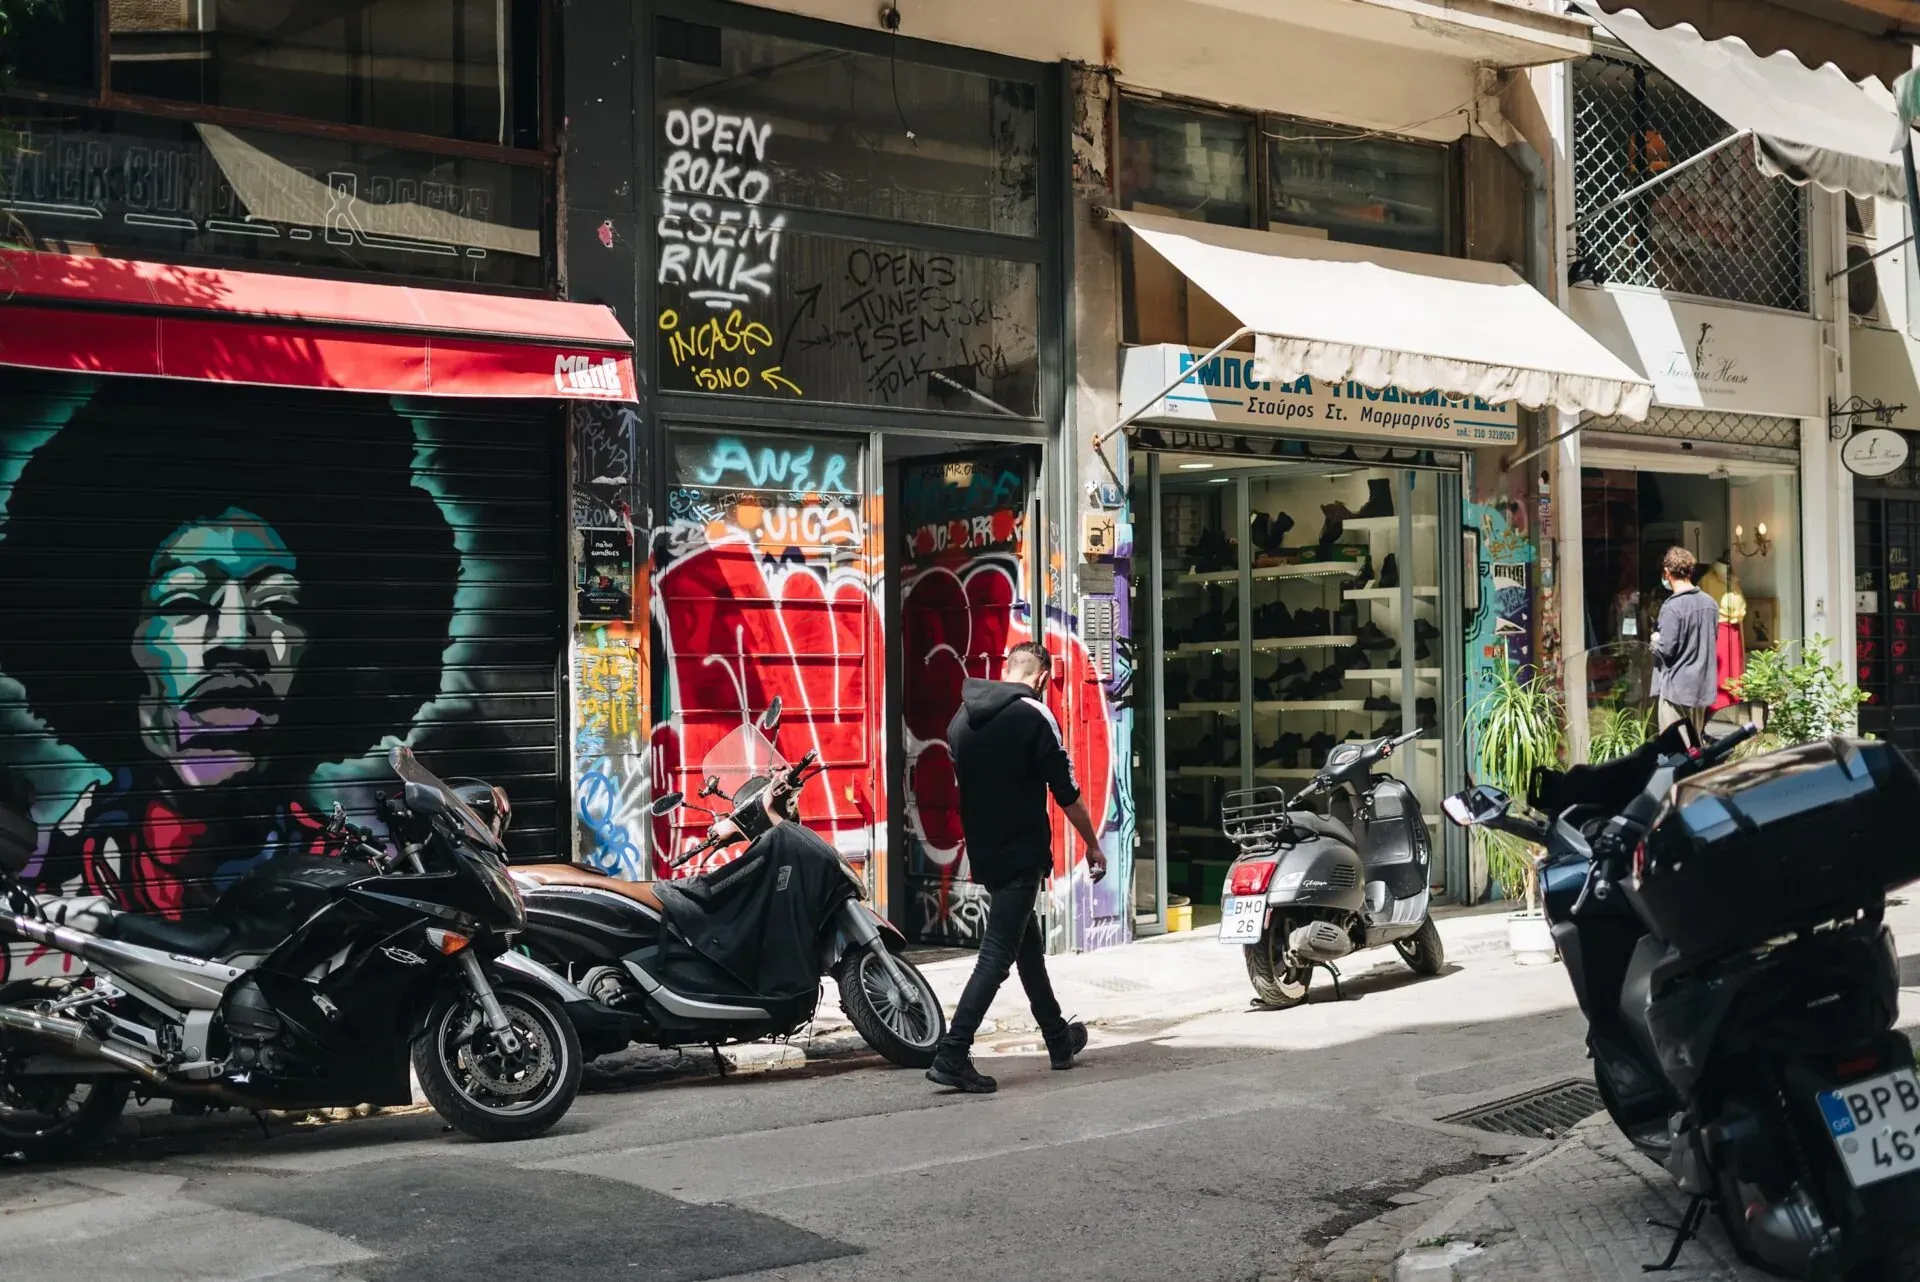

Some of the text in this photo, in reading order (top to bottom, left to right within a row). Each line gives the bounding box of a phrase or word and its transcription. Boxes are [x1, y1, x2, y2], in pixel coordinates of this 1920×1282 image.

[665, 108, 772, 163] OPEN
[664, 151, 770, 205] ROKO
[658, 201, 786, 261] ESEM
[659, 245, 774, 296] RMK
[1713, 356, 1750, 385] House
[1247, 396, 1314, 421] Σταύρος
[1325, 403, 1348, 421] Στ.
[1360, 406, 1450, 430] Μαρμαρινός
[1474, 429, 1486, 439] 210
[1488, 430, 1515, 441] 3218067
[1108, 489, 1116, 502] 8
[1234, 900, 1262, 915] BMO
[1236, 919, 1255, 933] 26
[1848, 1079, 1920, 1127] BPB
[1832, 1117, 1851, 1131] GR
